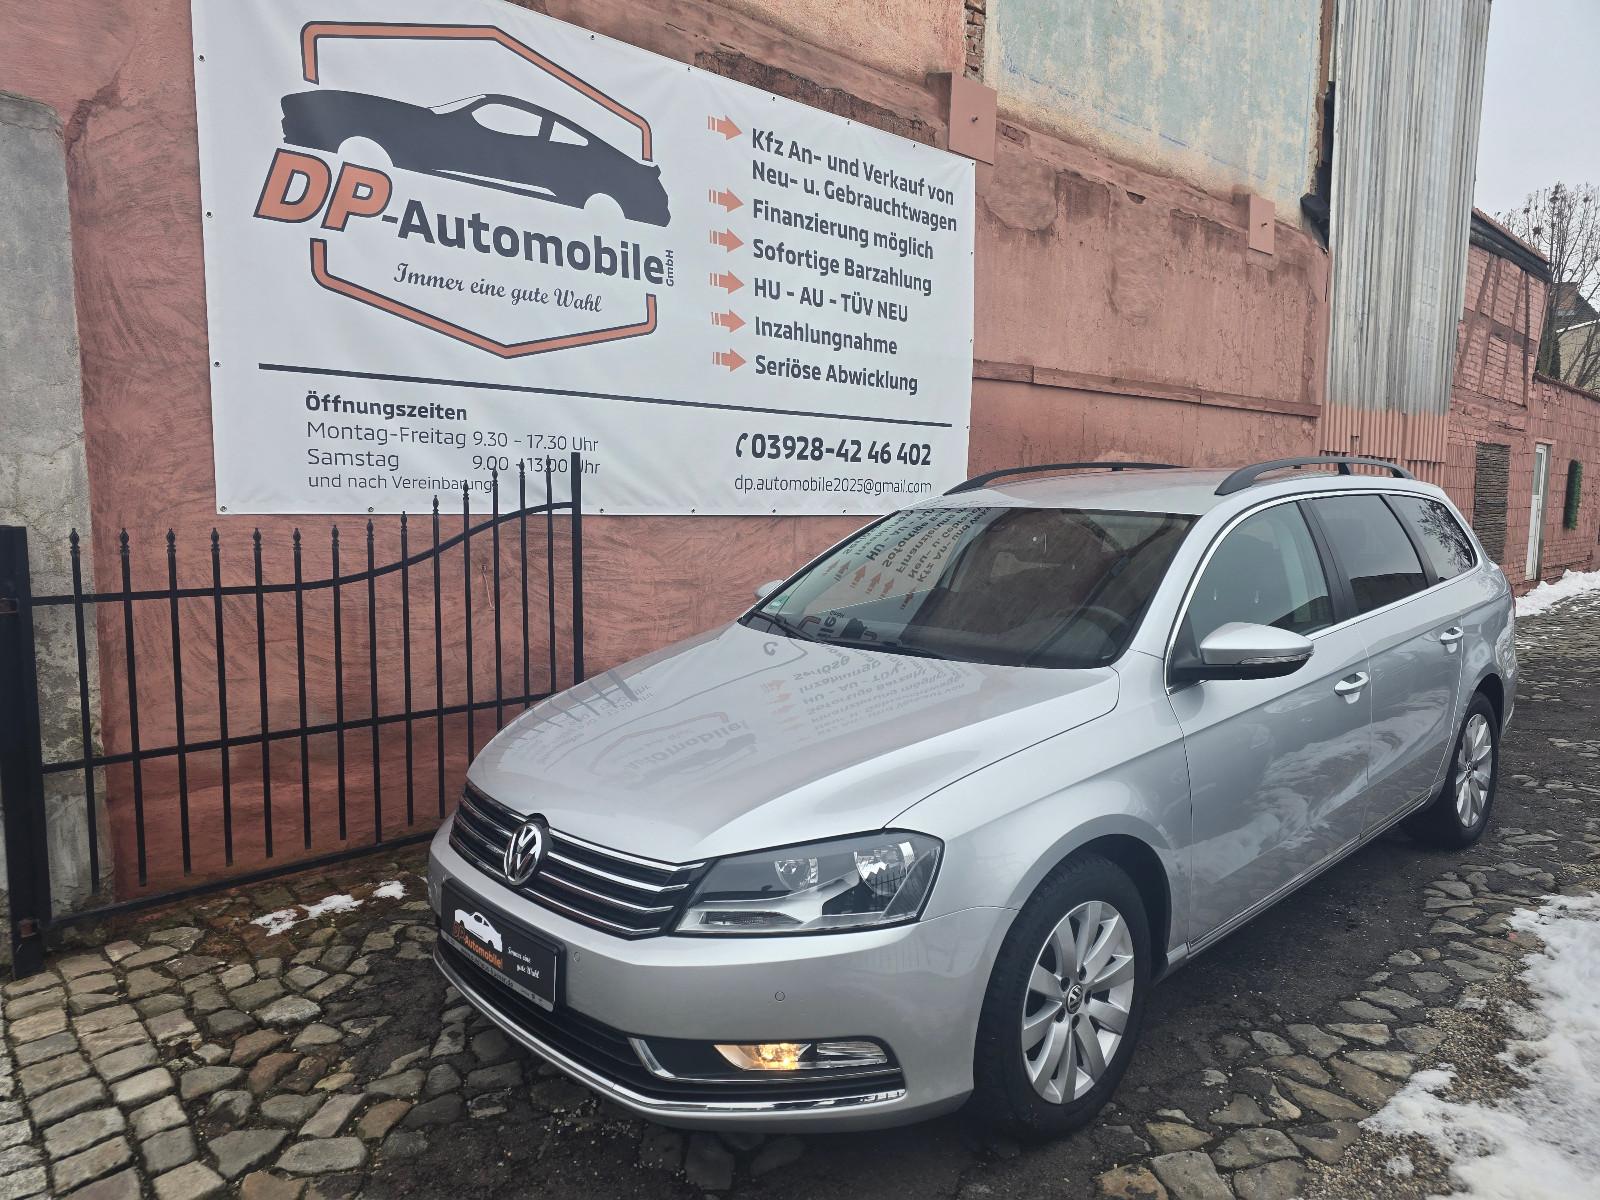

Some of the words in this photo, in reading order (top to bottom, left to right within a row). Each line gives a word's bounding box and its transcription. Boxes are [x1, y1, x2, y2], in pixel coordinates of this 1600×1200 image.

[752, 127, 784, 156] Kfz
[788, 140, 822, 164] An-
[827, 154, 860, 178] und
[862, 161, 925, 197] Verkauf
[927, 184, 954, 206] von
[752, 159, 799, 188] Neu-
[803, 177, 820, 197] u.
[824, 180, 957, 232] Gebrauchtwagen
[753, 198, 869, 248] Finanzierung
[873, 231, 934, 260] möglich
[665, 249, 674, 287] GmbH
[752, 238, 840, 277] Sofortige
[844, 257, 932, 297] Barzahlung
[393, 262, 464, 292] Immer
[470, 278, 505, 298] eine
[510, 285, 549, 306] gute
[553, 287, 602, 313] Wahl
[754, 277, 781, 301] HU
[799, 286, 824, 308] AU
[840, 291, 874, 317] TÜV
[877, 300, 908, 322] NEU
[755, 316, 898, 355] Inzahlungnahme
[755, 354, 822, 381] Seriöse
[825, 363, 918, 396] Abwicklung
[305, 390, 468, 421] Öffnungszeiten
[306, 421, 467, 449] Montag-Freitag
[472, 431, 508, 448] 9.30
[526, 434, 567, 450] 17.30
[572, 436, 599, 452] Uhr
[751, 433, 862, 463] 03928-42
[867, 440, 892, 464] 46
[896, 442, 932, 466] 402
[307, 448, 399, 471] Samstag
[472, 455, 509, 471] 9.00
[308, 473, 342, 488] und
[347, 475, 387, 490] nach
[391, 475, 493, 494] Vereinbarung
[734, 474, 932, 497] dp.automobile2025@gmail.com
